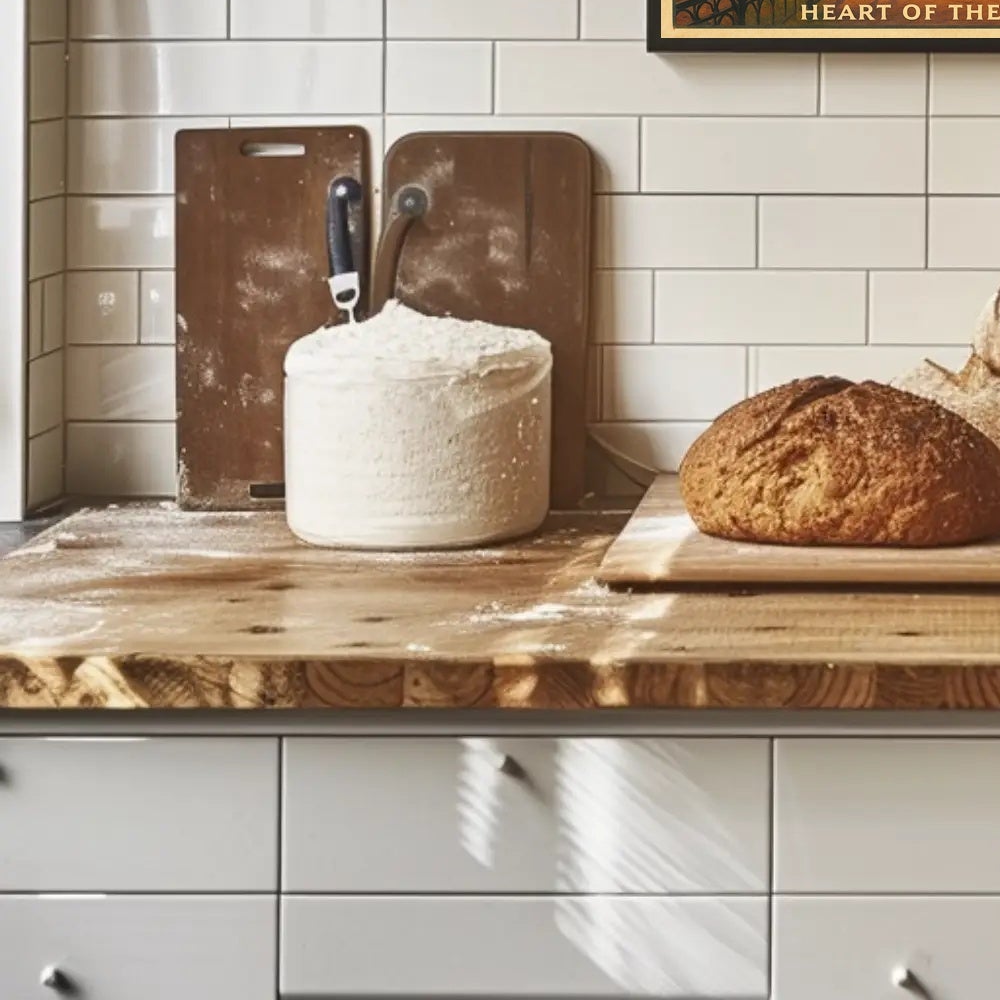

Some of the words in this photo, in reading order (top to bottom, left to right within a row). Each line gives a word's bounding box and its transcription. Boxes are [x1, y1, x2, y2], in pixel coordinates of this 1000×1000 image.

[801, 3, 892, 21] HEART
[902, 3, 937, 21] OF
[949, 3, 1000, 21] THE
